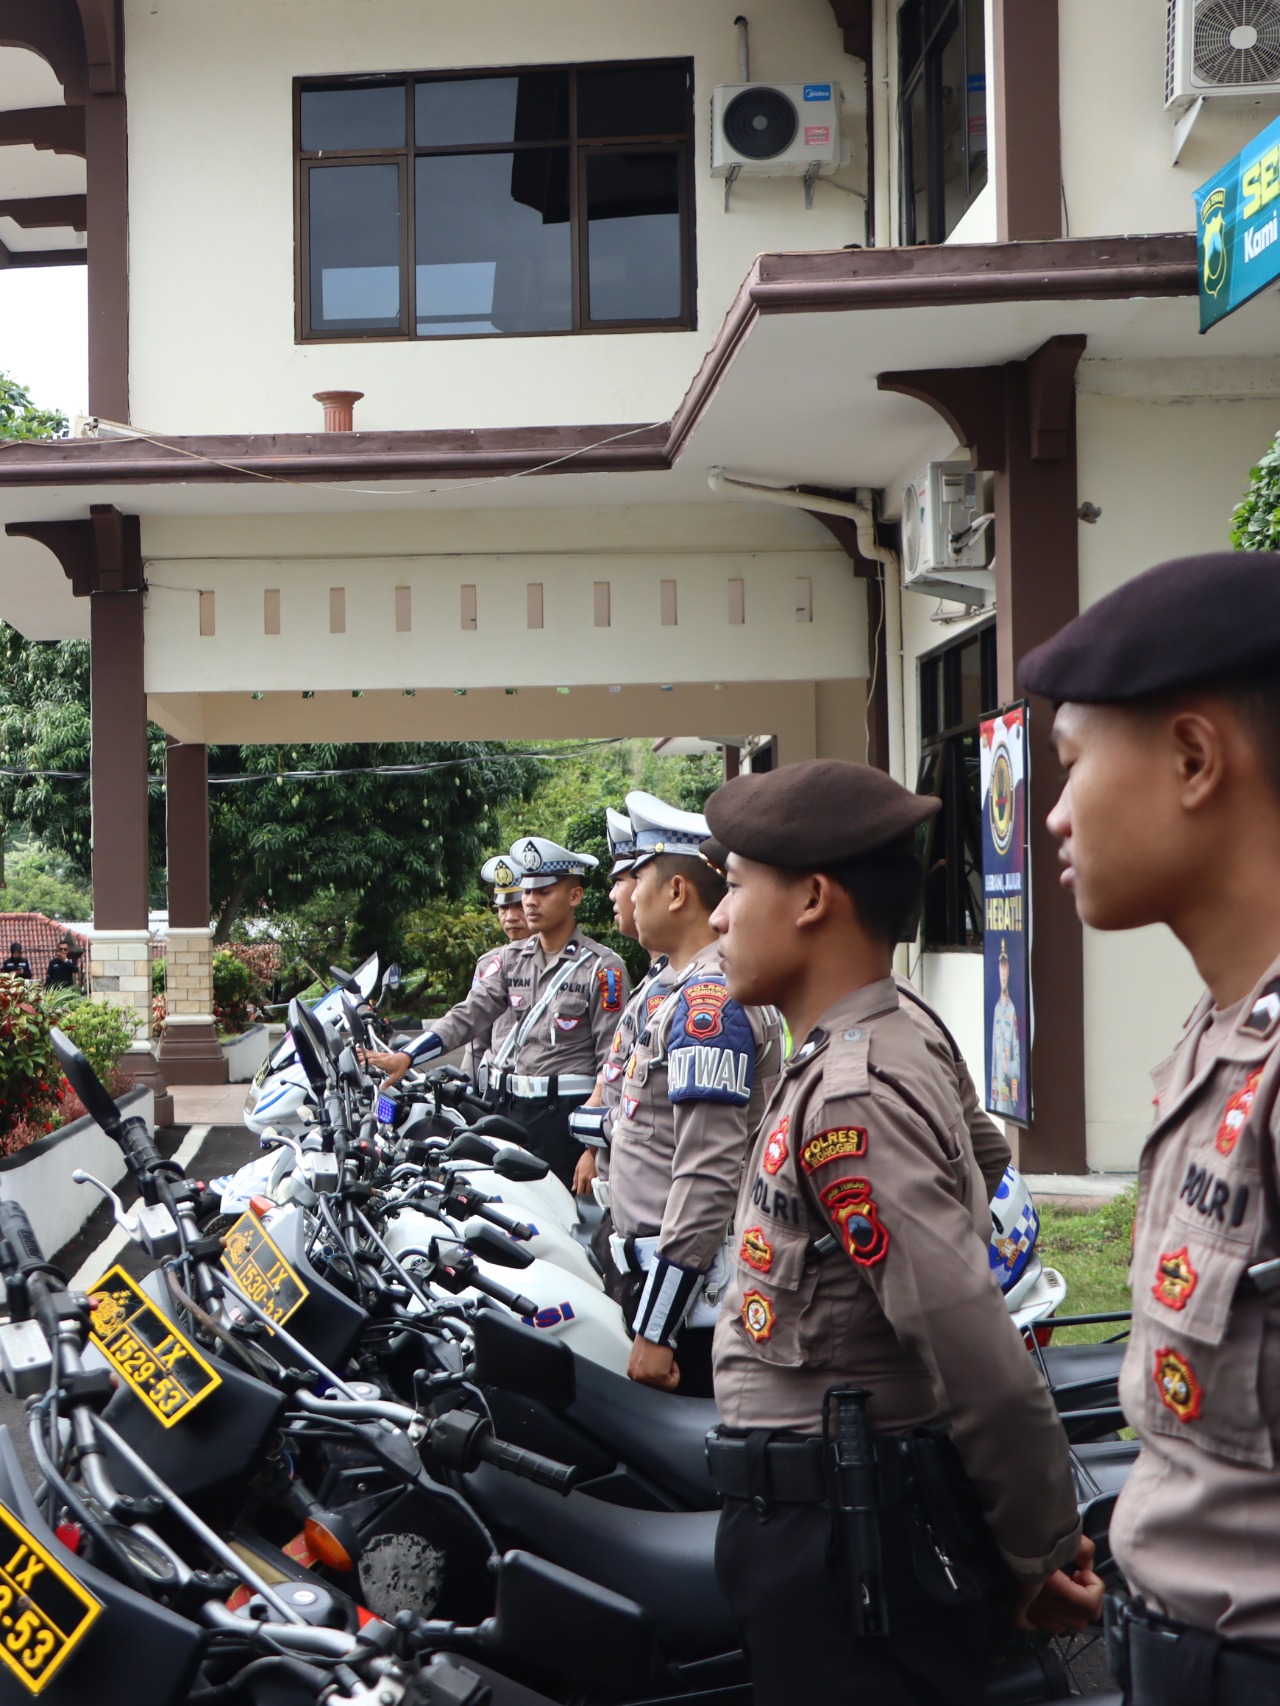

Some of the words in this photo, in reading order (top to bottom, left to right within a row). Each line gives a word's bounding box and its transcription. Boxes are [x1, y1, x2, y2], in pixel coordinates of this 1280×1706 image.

[1244, 209, 1278, 264] Kami
[985, 895, 1022, 931] HEBAT!!
[668, 1045, 751, 1099] ATWAL
[804, 1129, 859, 1162] POLRES
[1180, 1162, 1250, 1228] POLRI
[266, 1261, 289, 1285] IX
[109, 1333, 182, 1412] 1529-53
[153, 1334, 187, 1368] IX
[4, 1544, 45, 1590] IX
